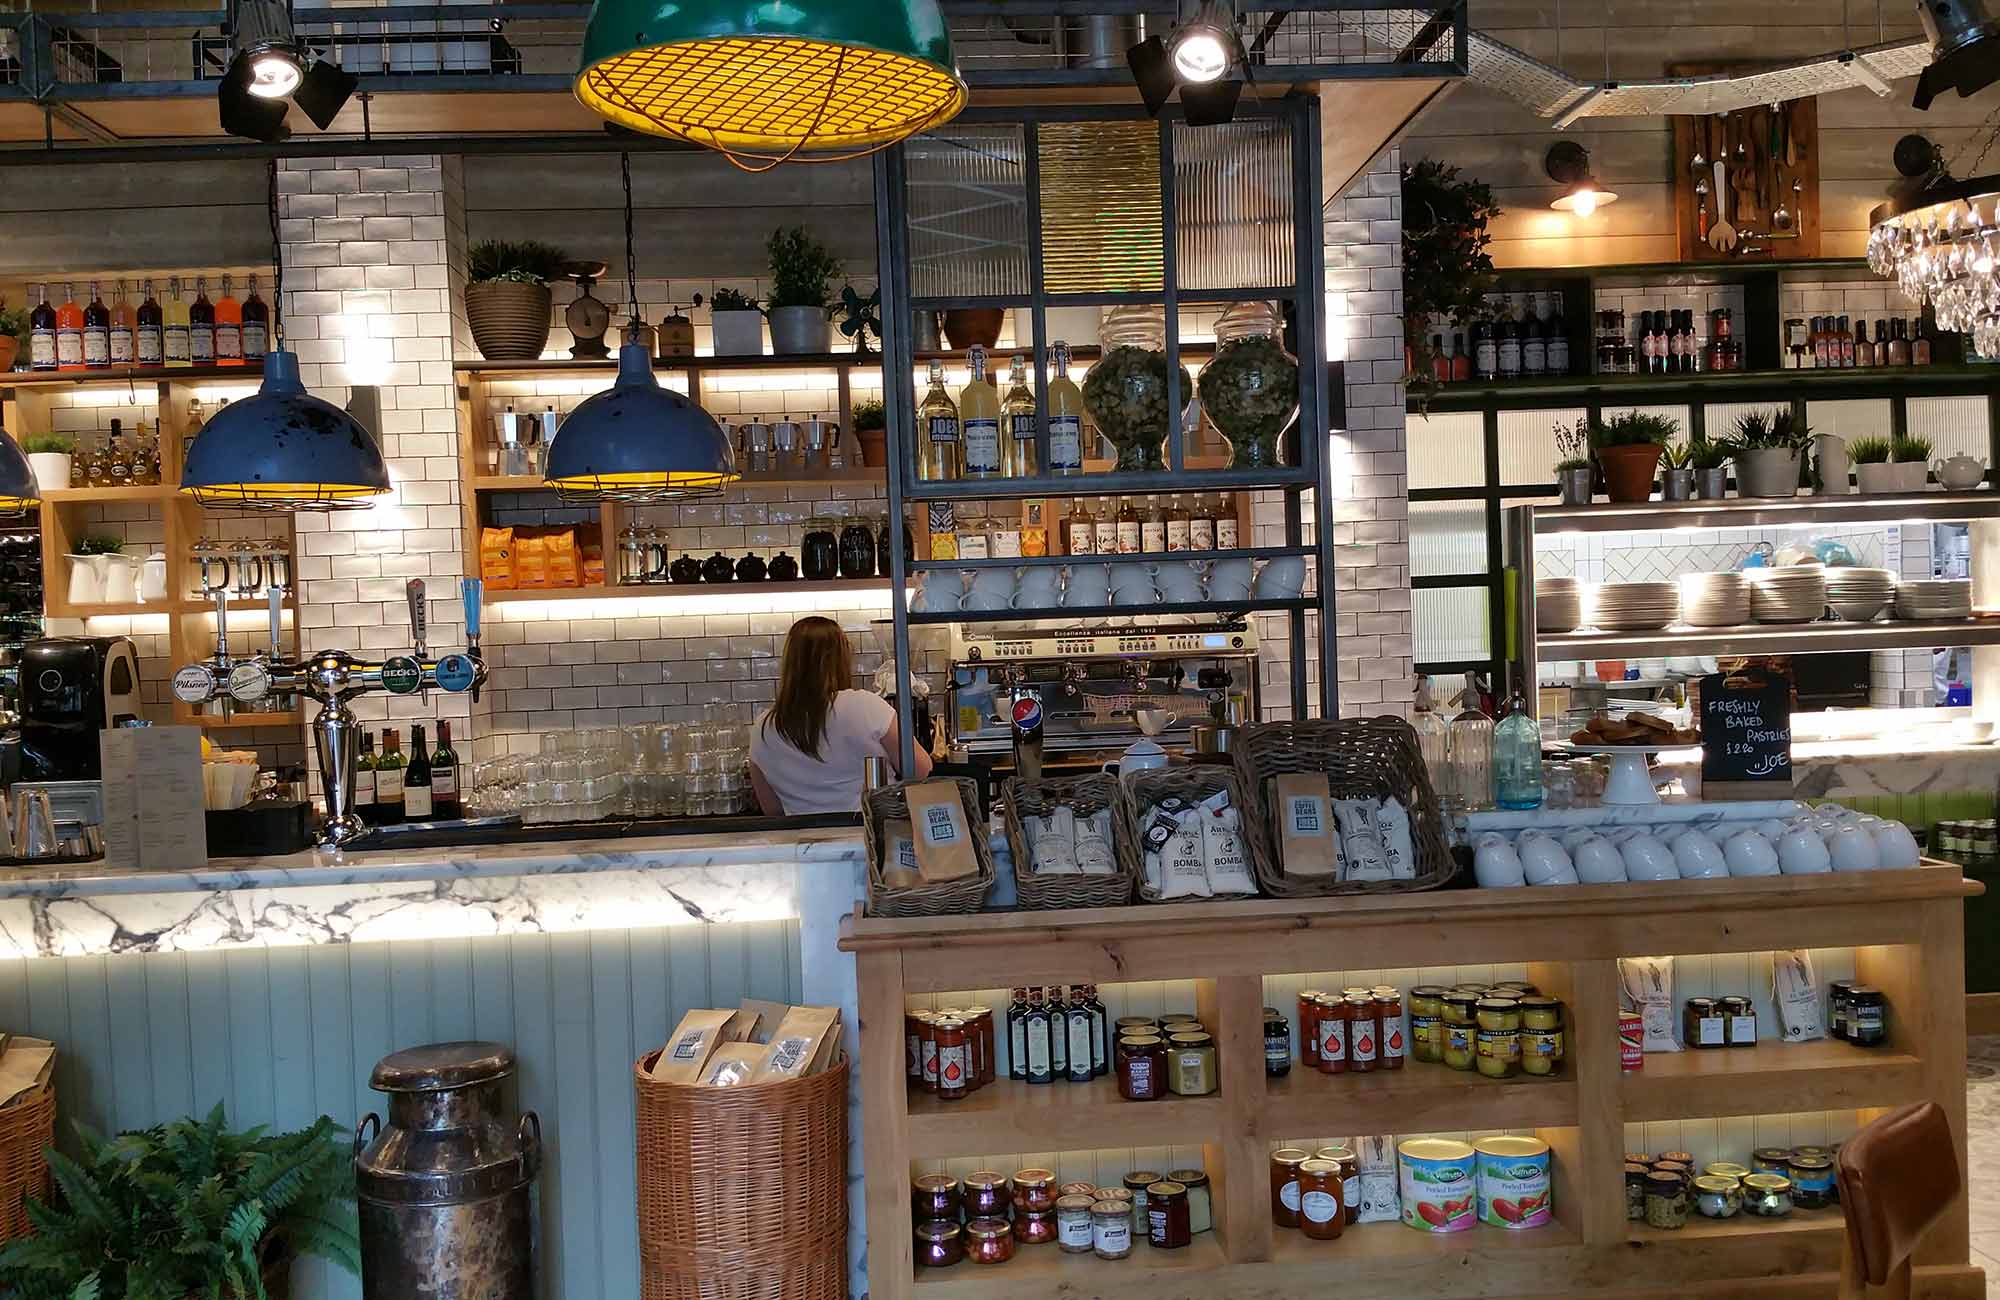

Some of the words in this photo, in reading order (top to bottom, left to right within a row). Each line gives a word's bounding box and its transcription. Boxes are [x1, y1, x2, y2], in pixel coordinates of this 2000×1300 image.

[175, 680, 208, 690] Pilsner
[1709, 700, 1760, 714] FRESHLY
[1726, 715, 1763, 728] BAKED
[1747, 728, 1791, 743] PASTRIES
